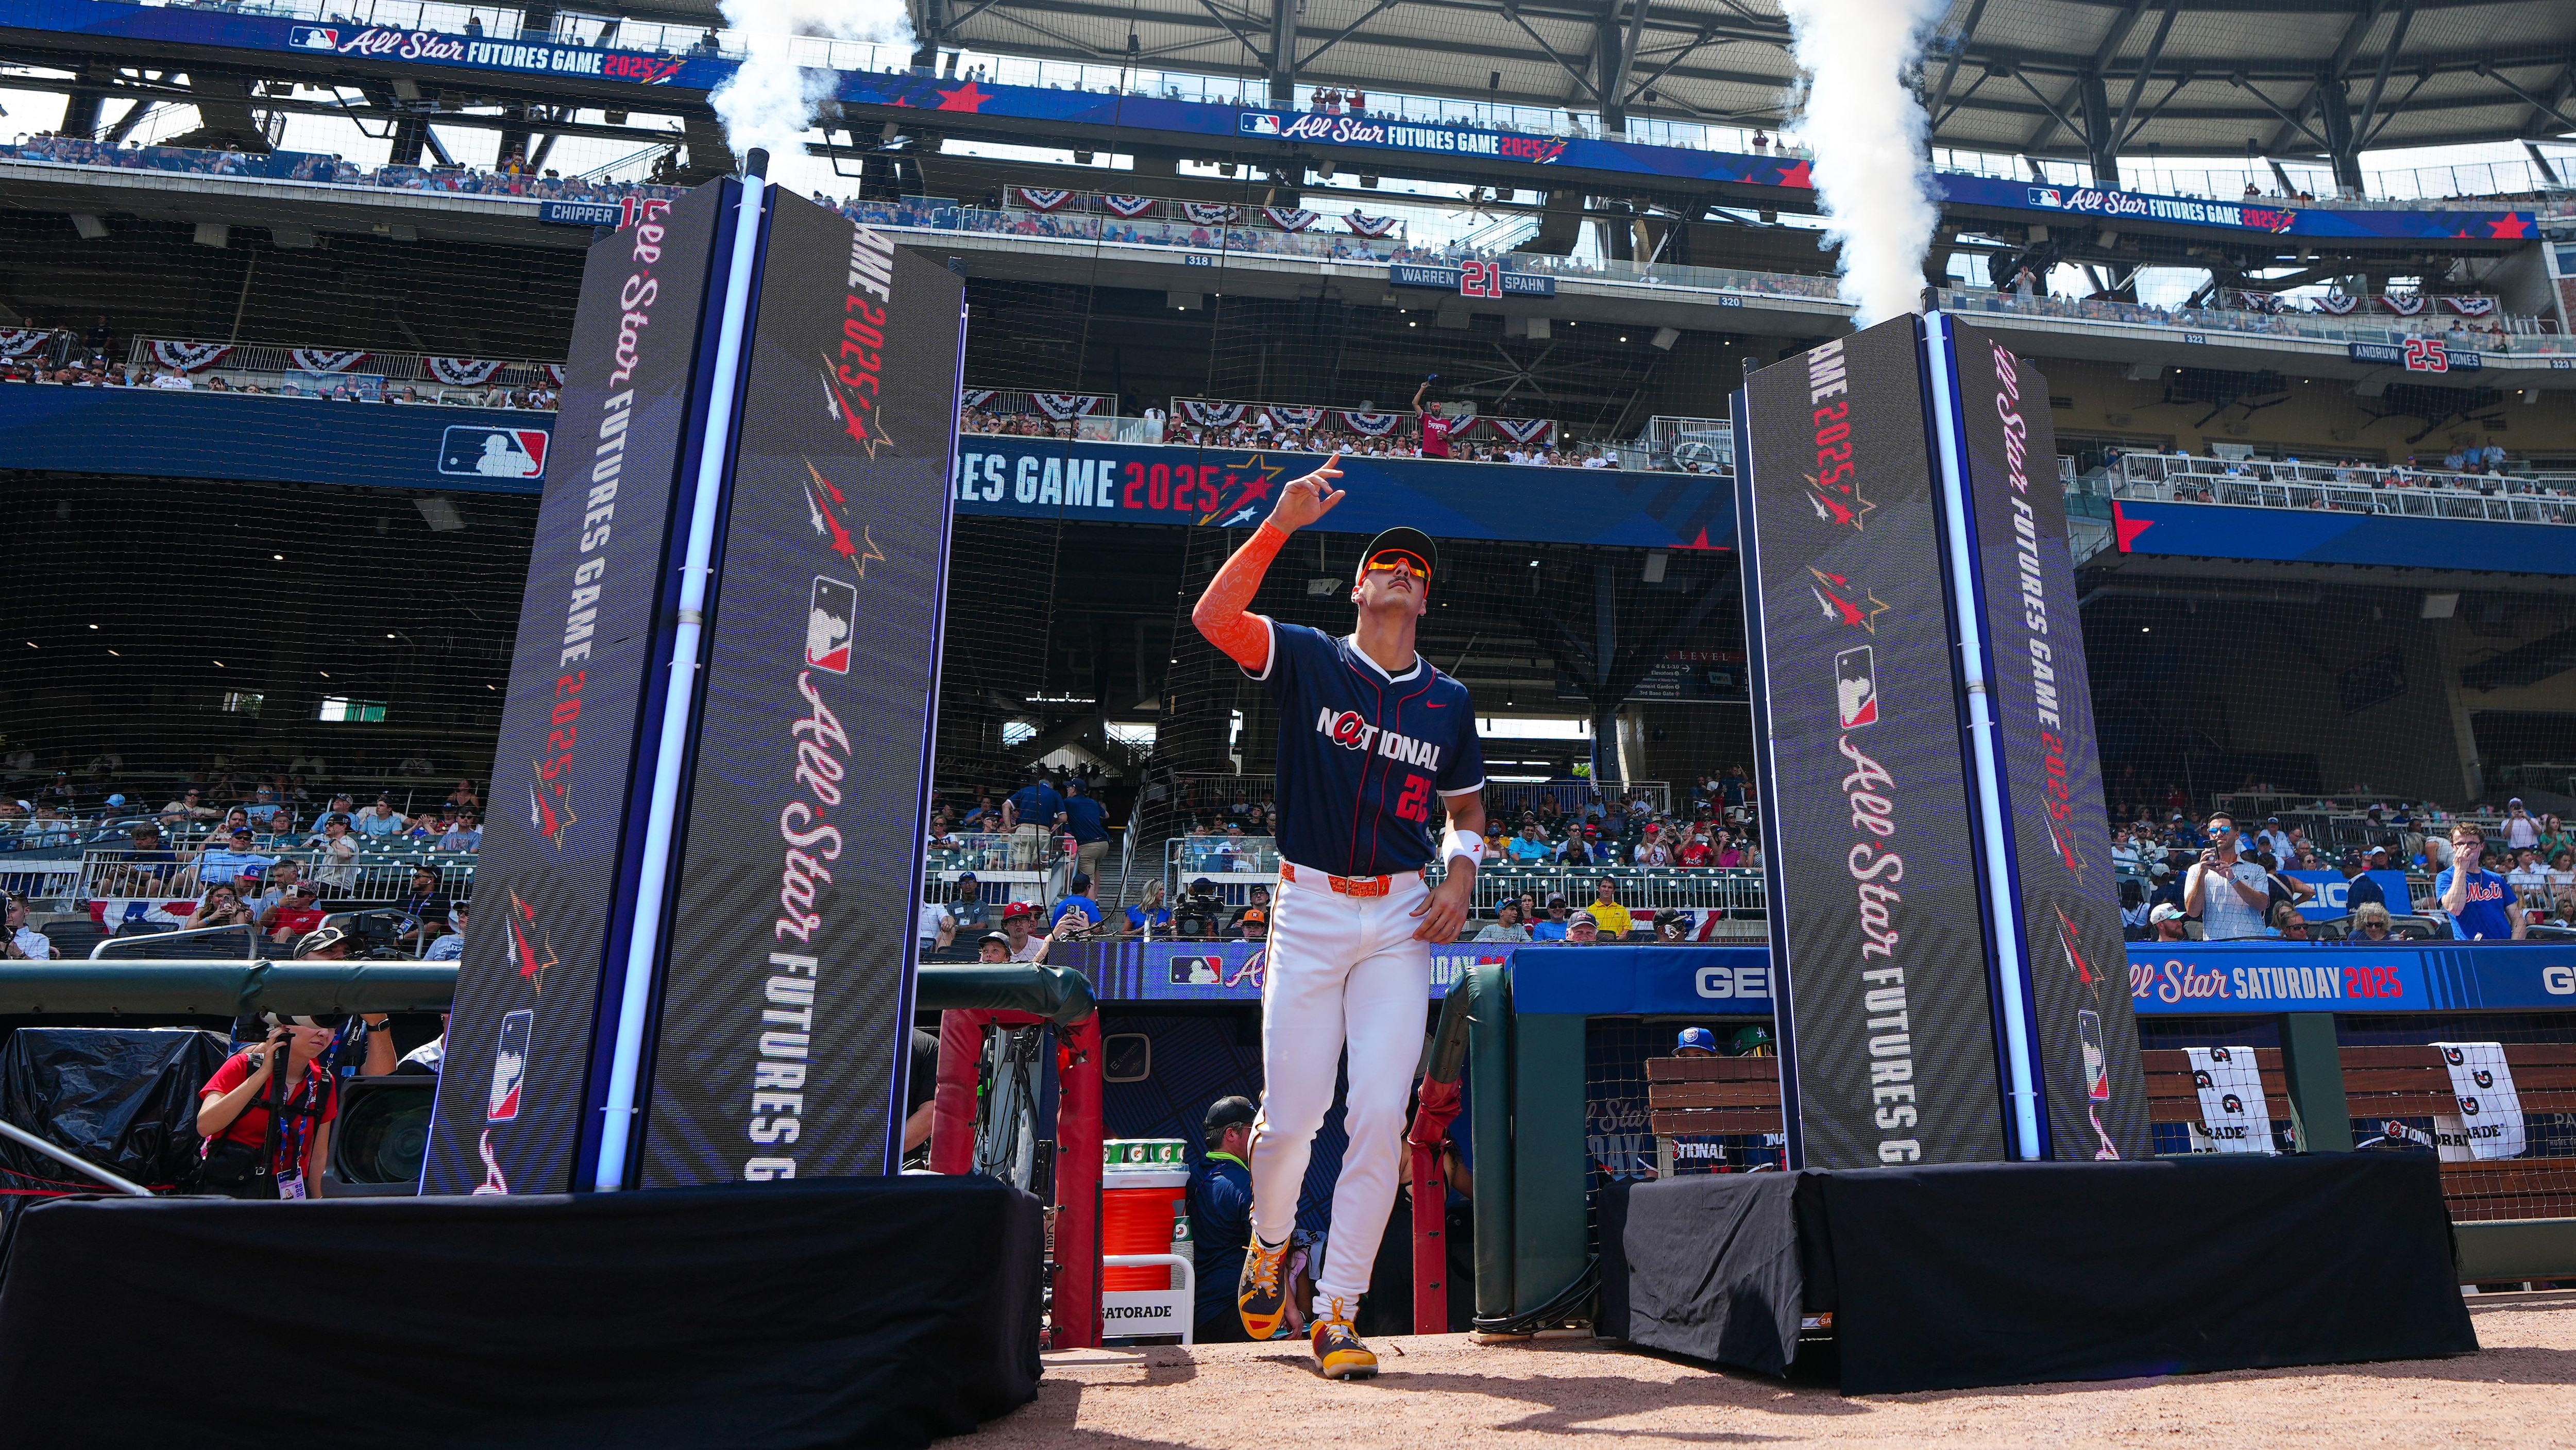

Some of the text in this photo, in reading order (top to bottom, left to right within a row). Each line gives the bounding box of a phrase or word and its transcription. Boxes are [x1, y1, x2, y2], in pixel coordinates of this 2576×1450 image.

[338, 28, 655, 77] All Star FUTURES GAME 2025
[1281, 114, 1541, 158] All Star FUTURES GAME 2025
[551, 204, 613, 222] CHIPPER
[2063, 189, 2278, 228] All Star FUTURES GAME 2025
[1189, 256, 1209, 265] 318
[1401, 260, 1545, 299] WARREN 21 SPAHN
[1722, 297, 1740, 307] 320
[610, 274, 658, 390] Star
[838, 294, 886, 396] 2025
[2188, 335, 2204, 344] 322
[2355, 338, 2479, 374] ANDRUW 25 JONES
[2553, 360, 2569, 369] 323
[580, 389, 634, 553] FUTURES
[1014, 456, 1116, 508] GAME
[1123, 461, 1220, 512] 2025
[1814, 401, 1855, 486] 2025
[1996, 392, 2028, 495] Star
[2011, 496, 2048, 635] FUTURES
[560, 557, 605, 667] GAME
[1679, 650, 1728, 661] LEVEL
[2029, 637, 2060, 731] GAME
[541, 670, 586, 781] 2025
[792, 670, 852, 806] All
[1839, 734, 1896, 837] All
[2042, 731, 2073, 823] 2025
[776, 800, 843, 942] Star
[1849, 841, 1904, 962] Star
[2158, 959, 2232, 1004] Star
[2232, 967, 2341, 1000] SATURDAY
[2343, 966, 2403, 999] 2025
[749, 952, 818, 1144] FUTURES
[1118, 1041, 1139, 1063] Extreme
[1862, 967, 1918, 1129] FUTURES
[1103, 1306, 1172, 1319] ATORADE
